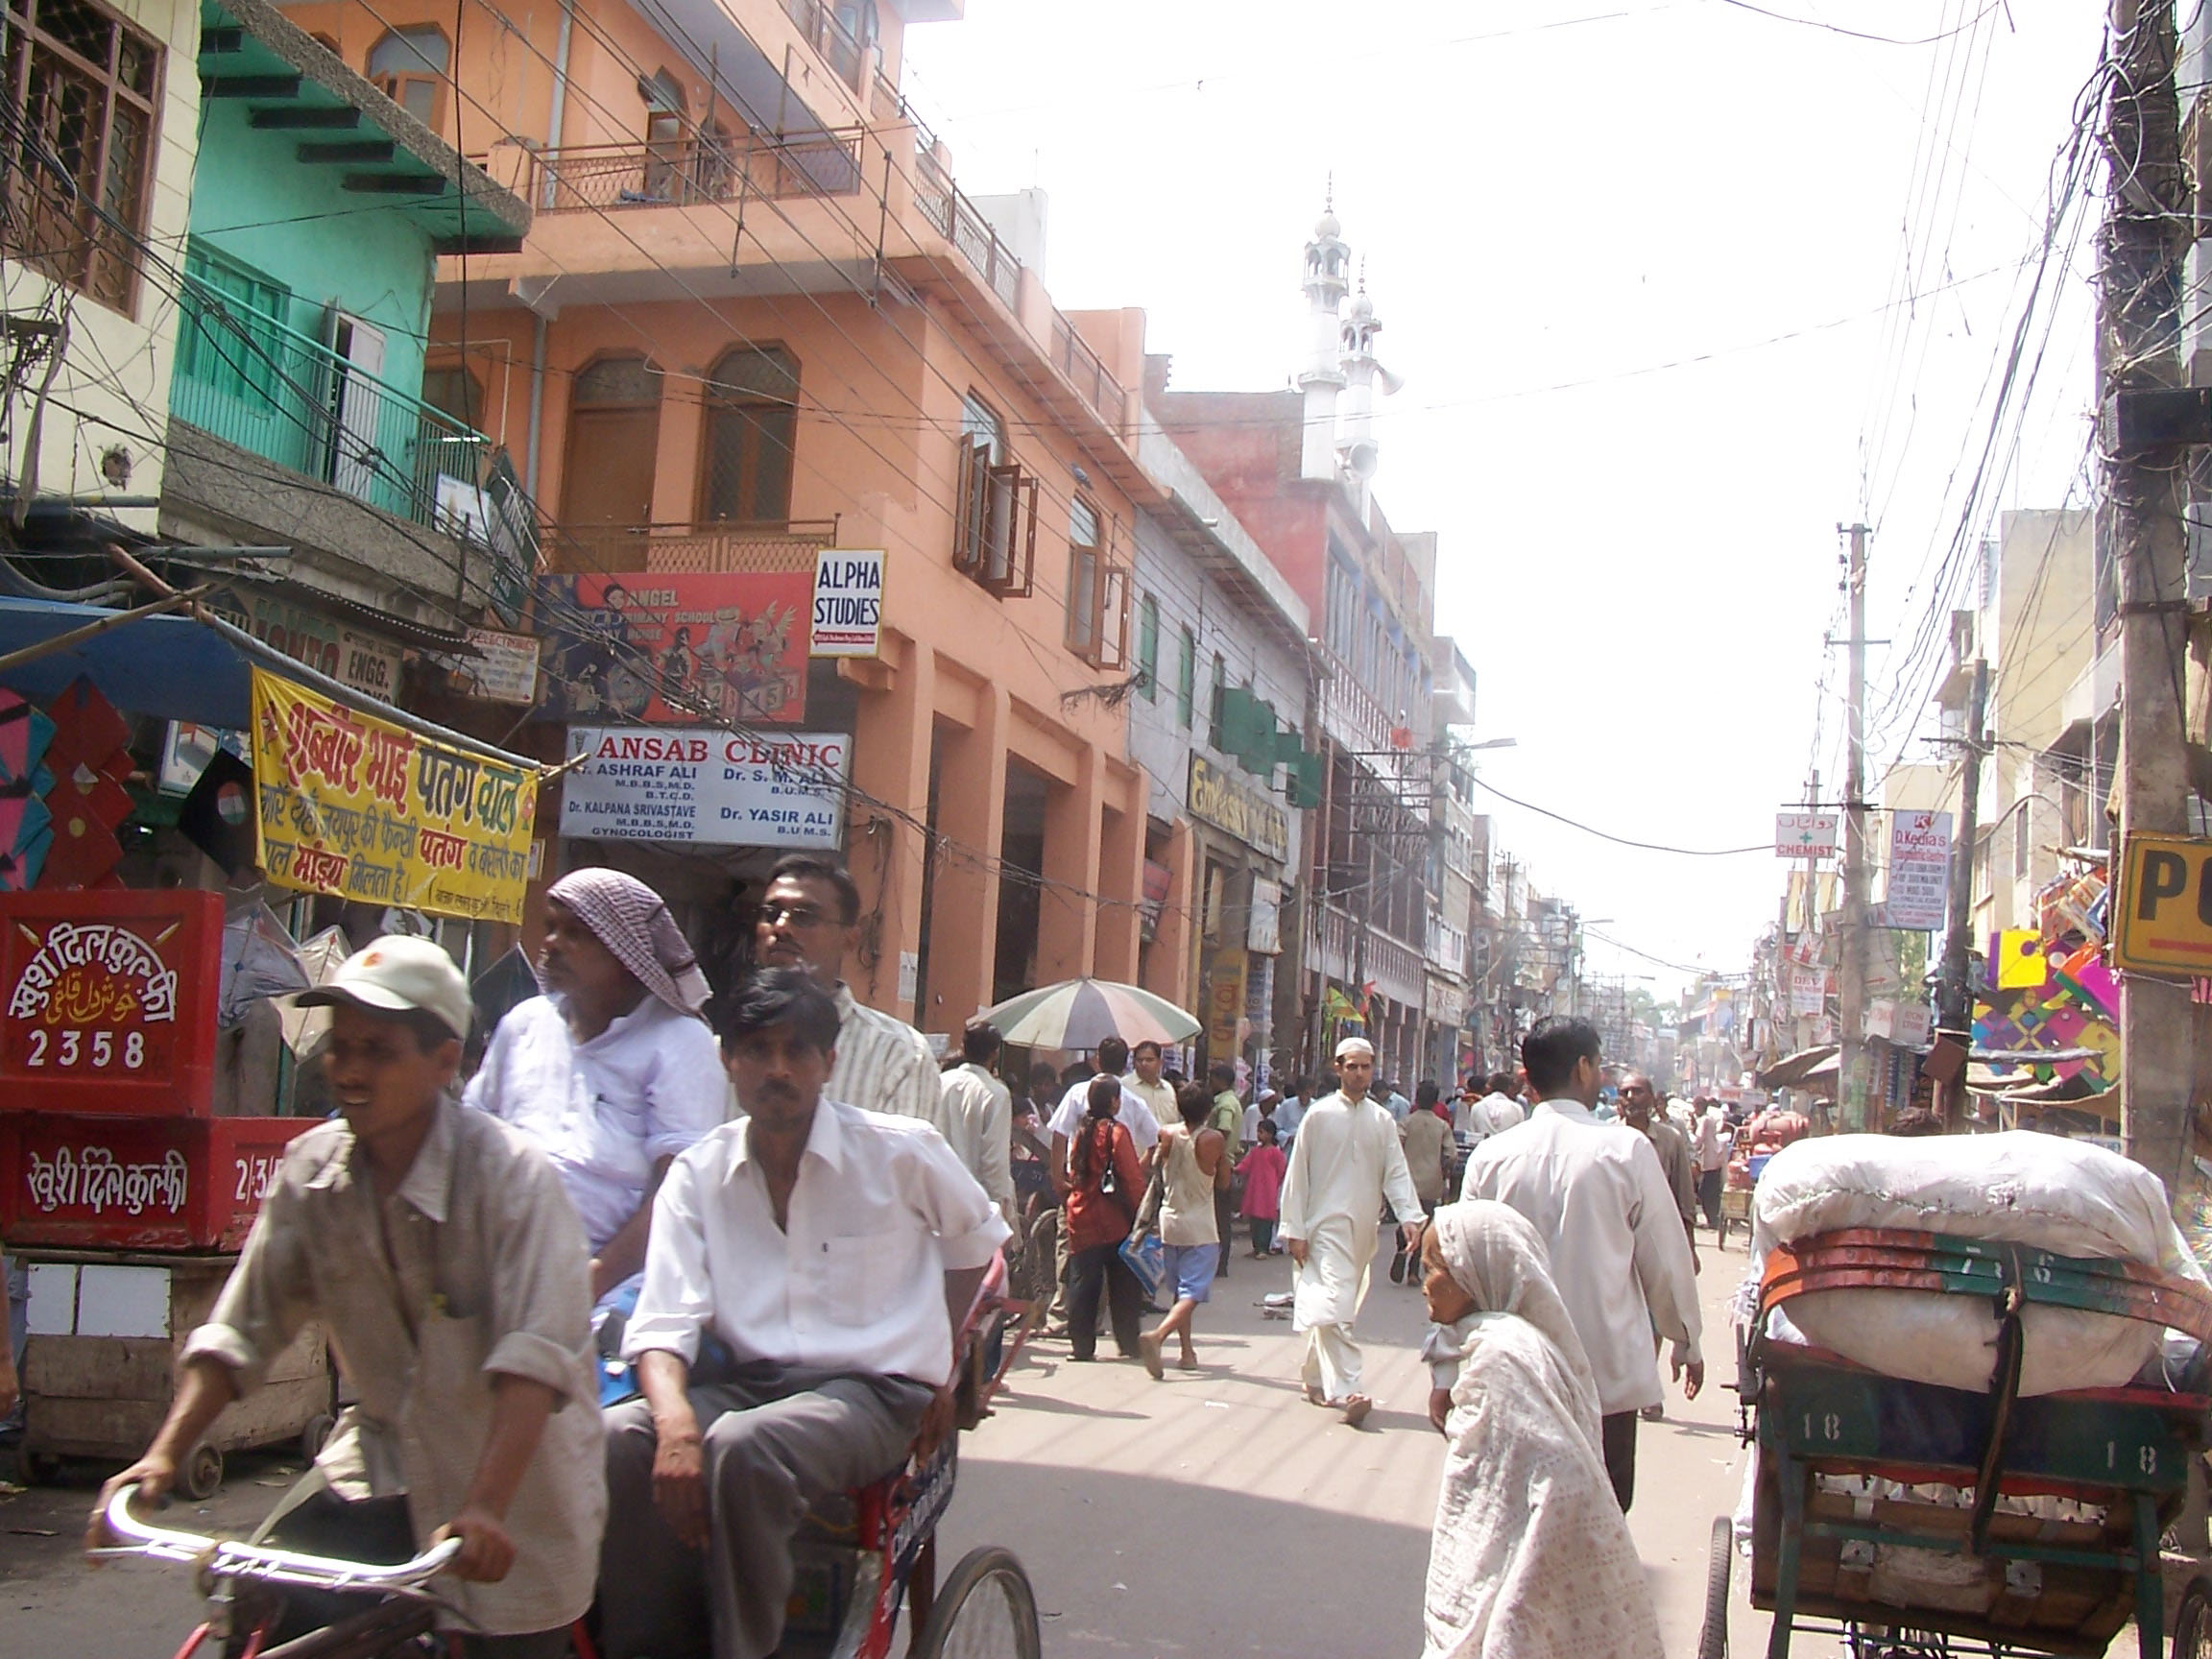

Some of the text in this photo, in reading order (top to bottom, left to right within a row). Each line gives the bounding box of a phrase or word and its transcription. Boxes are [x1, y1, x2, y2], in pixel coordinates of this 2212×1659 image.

[818, 561, 880, 589] ALPHA
[626, 589, 679, 608] ANGEL
[674, 611, 715, 623] SCHOOL
[814, 597, 879, 625] STUDIES
[596, 735, 842, 768] ANSAB CLINIC
[597, 763, 665, 778] ASHRAF
[669, 766, 697, 780] ALI
[723, 768, 746, 781] Dr.
[753, 770, 768, 782] S.
[568, 801, 696, 818] Dr. KALPANA SRIVASTAVE
[720, 807, 833, 826] Dr. YASIR ALI
[592, 827, 695, 839] GYNOCOLOGIST
[420, 824, 469, 872] पतंग
[1777, 844, 1833, 856] CHEMIST
